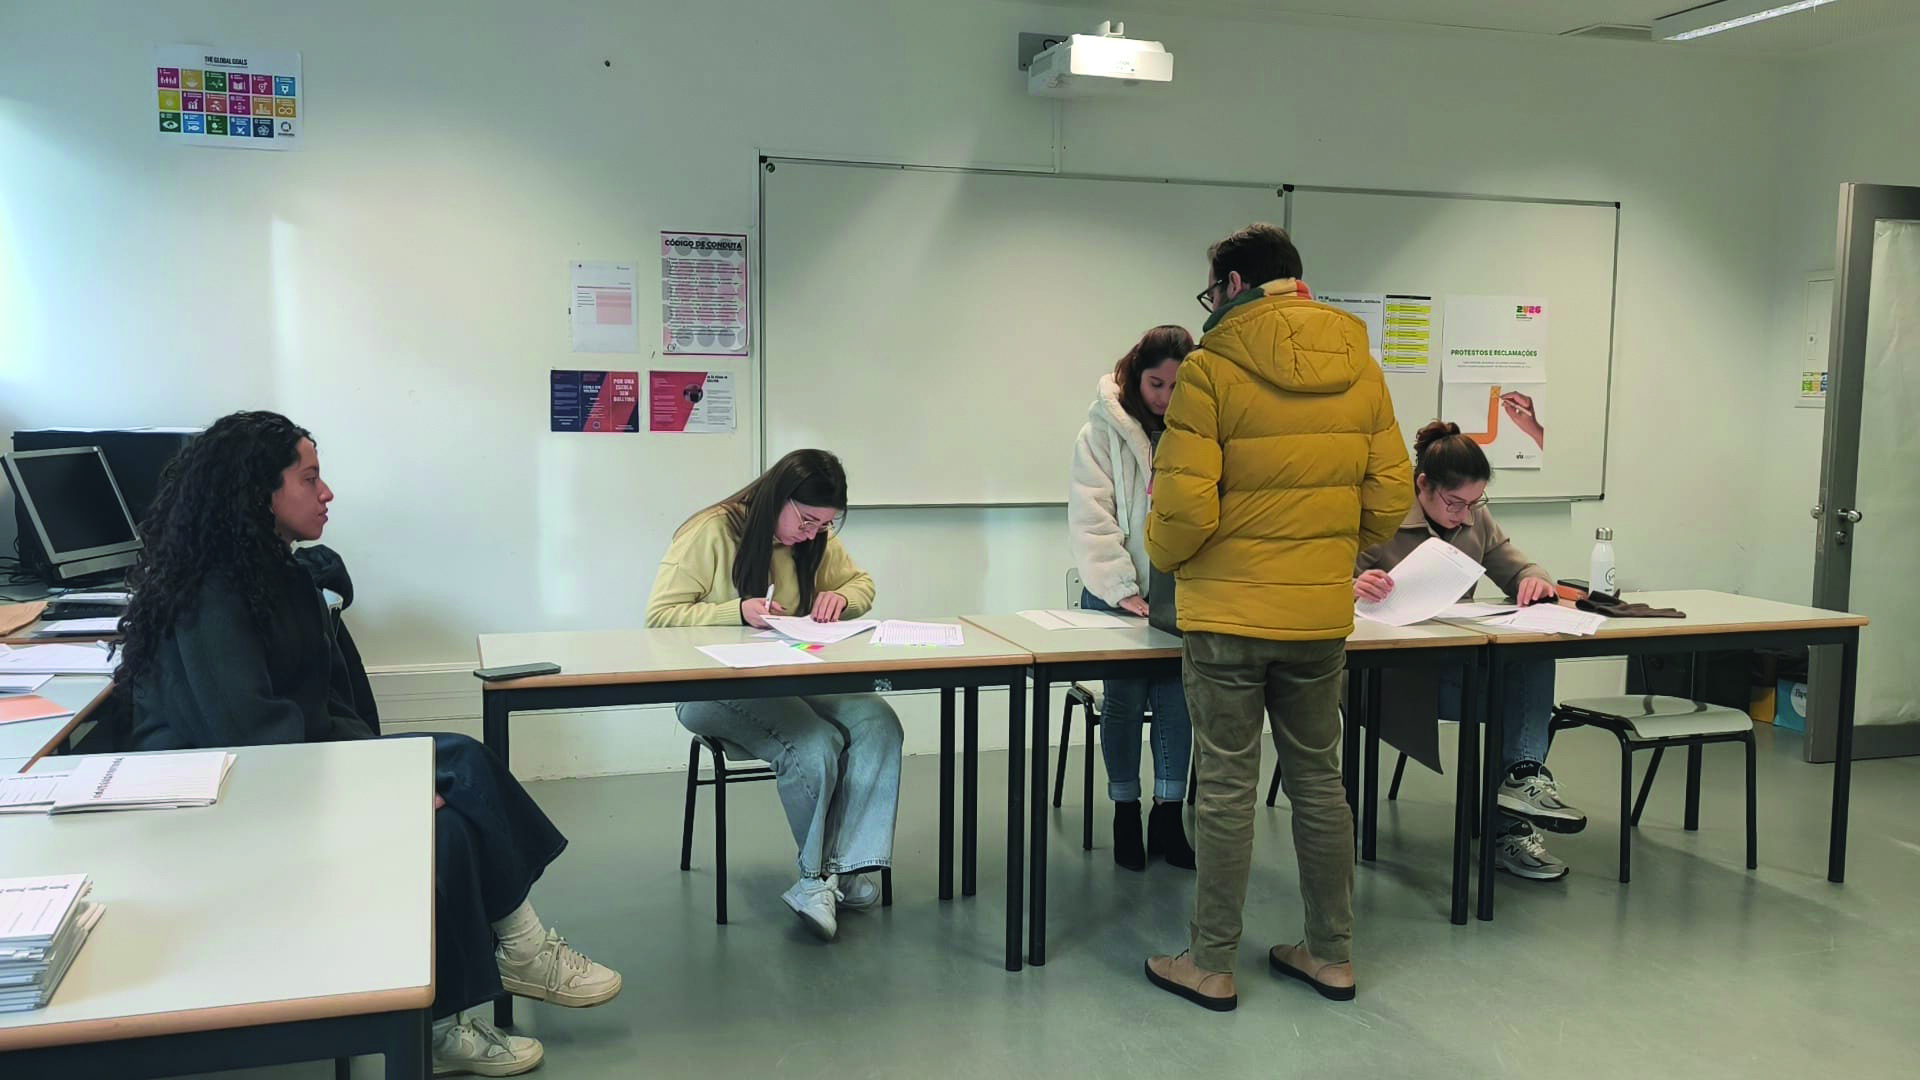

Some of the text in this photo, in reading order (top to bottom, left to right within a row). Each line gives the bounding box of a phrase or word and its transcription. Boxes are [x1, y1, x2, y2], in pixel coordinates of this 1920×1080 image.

[204, 55, 248, 66] THE GLOBAL GOALS
[664, 238, 694, 247] CÓDIGO
[695, 240, 705, 248] DE
[706, 241, 742, 249] CONDUTA
[1516, 305, 1541, 314] 2026
[1493, 349, 1538, 358] RECLAMAÇÕES
